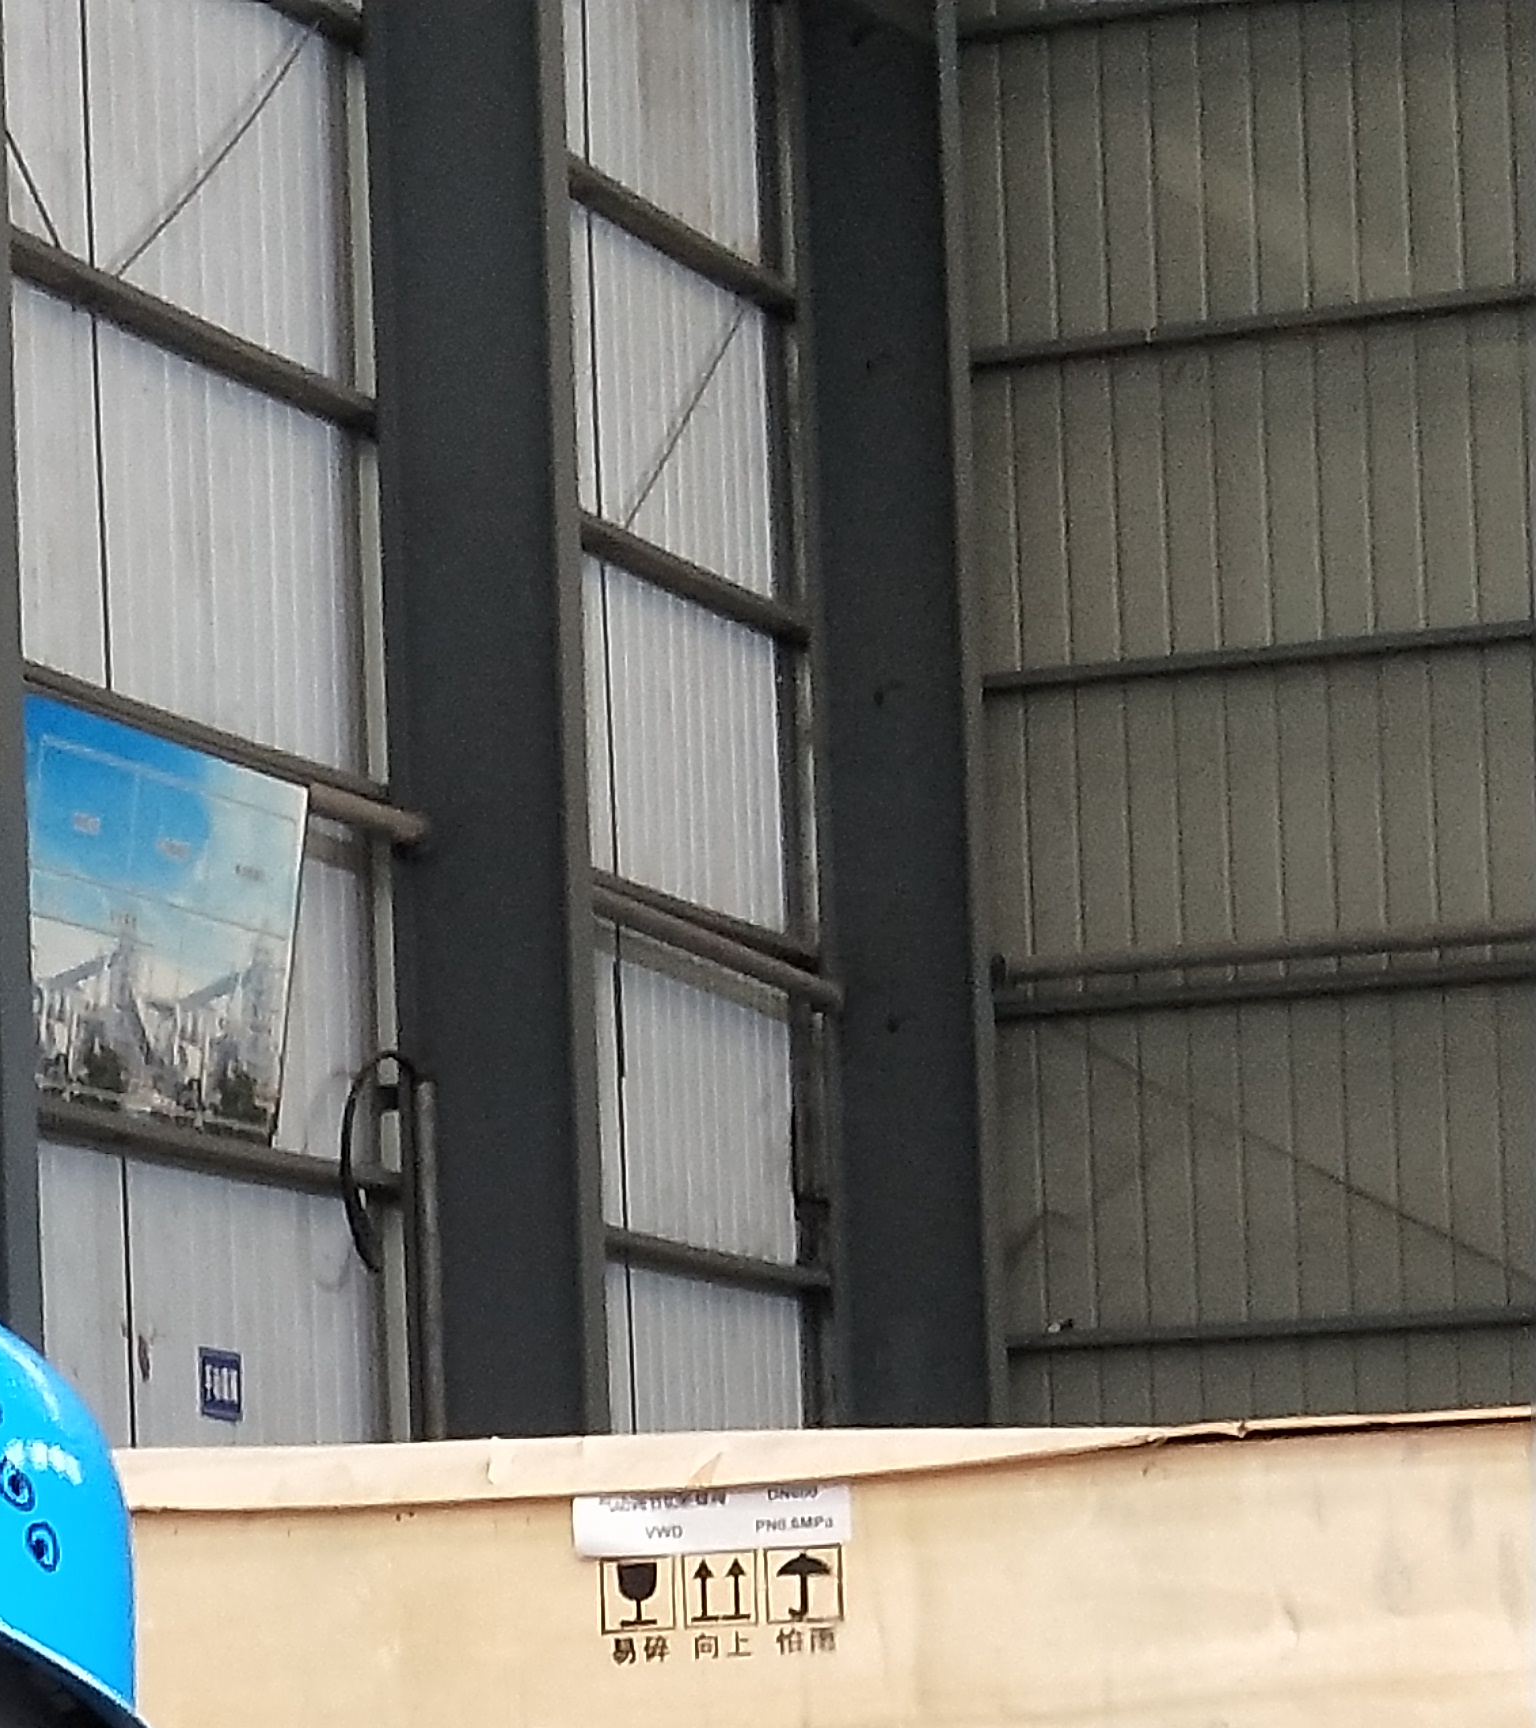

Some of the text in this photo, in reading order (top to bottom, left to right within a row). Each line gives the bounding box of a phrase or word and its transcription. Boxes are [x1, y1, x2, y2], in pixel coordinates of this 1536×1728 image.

[645, 1525, 684, 1539] VWD
[613, 1627, 837, 1665] 易碎 向上 怕雨
